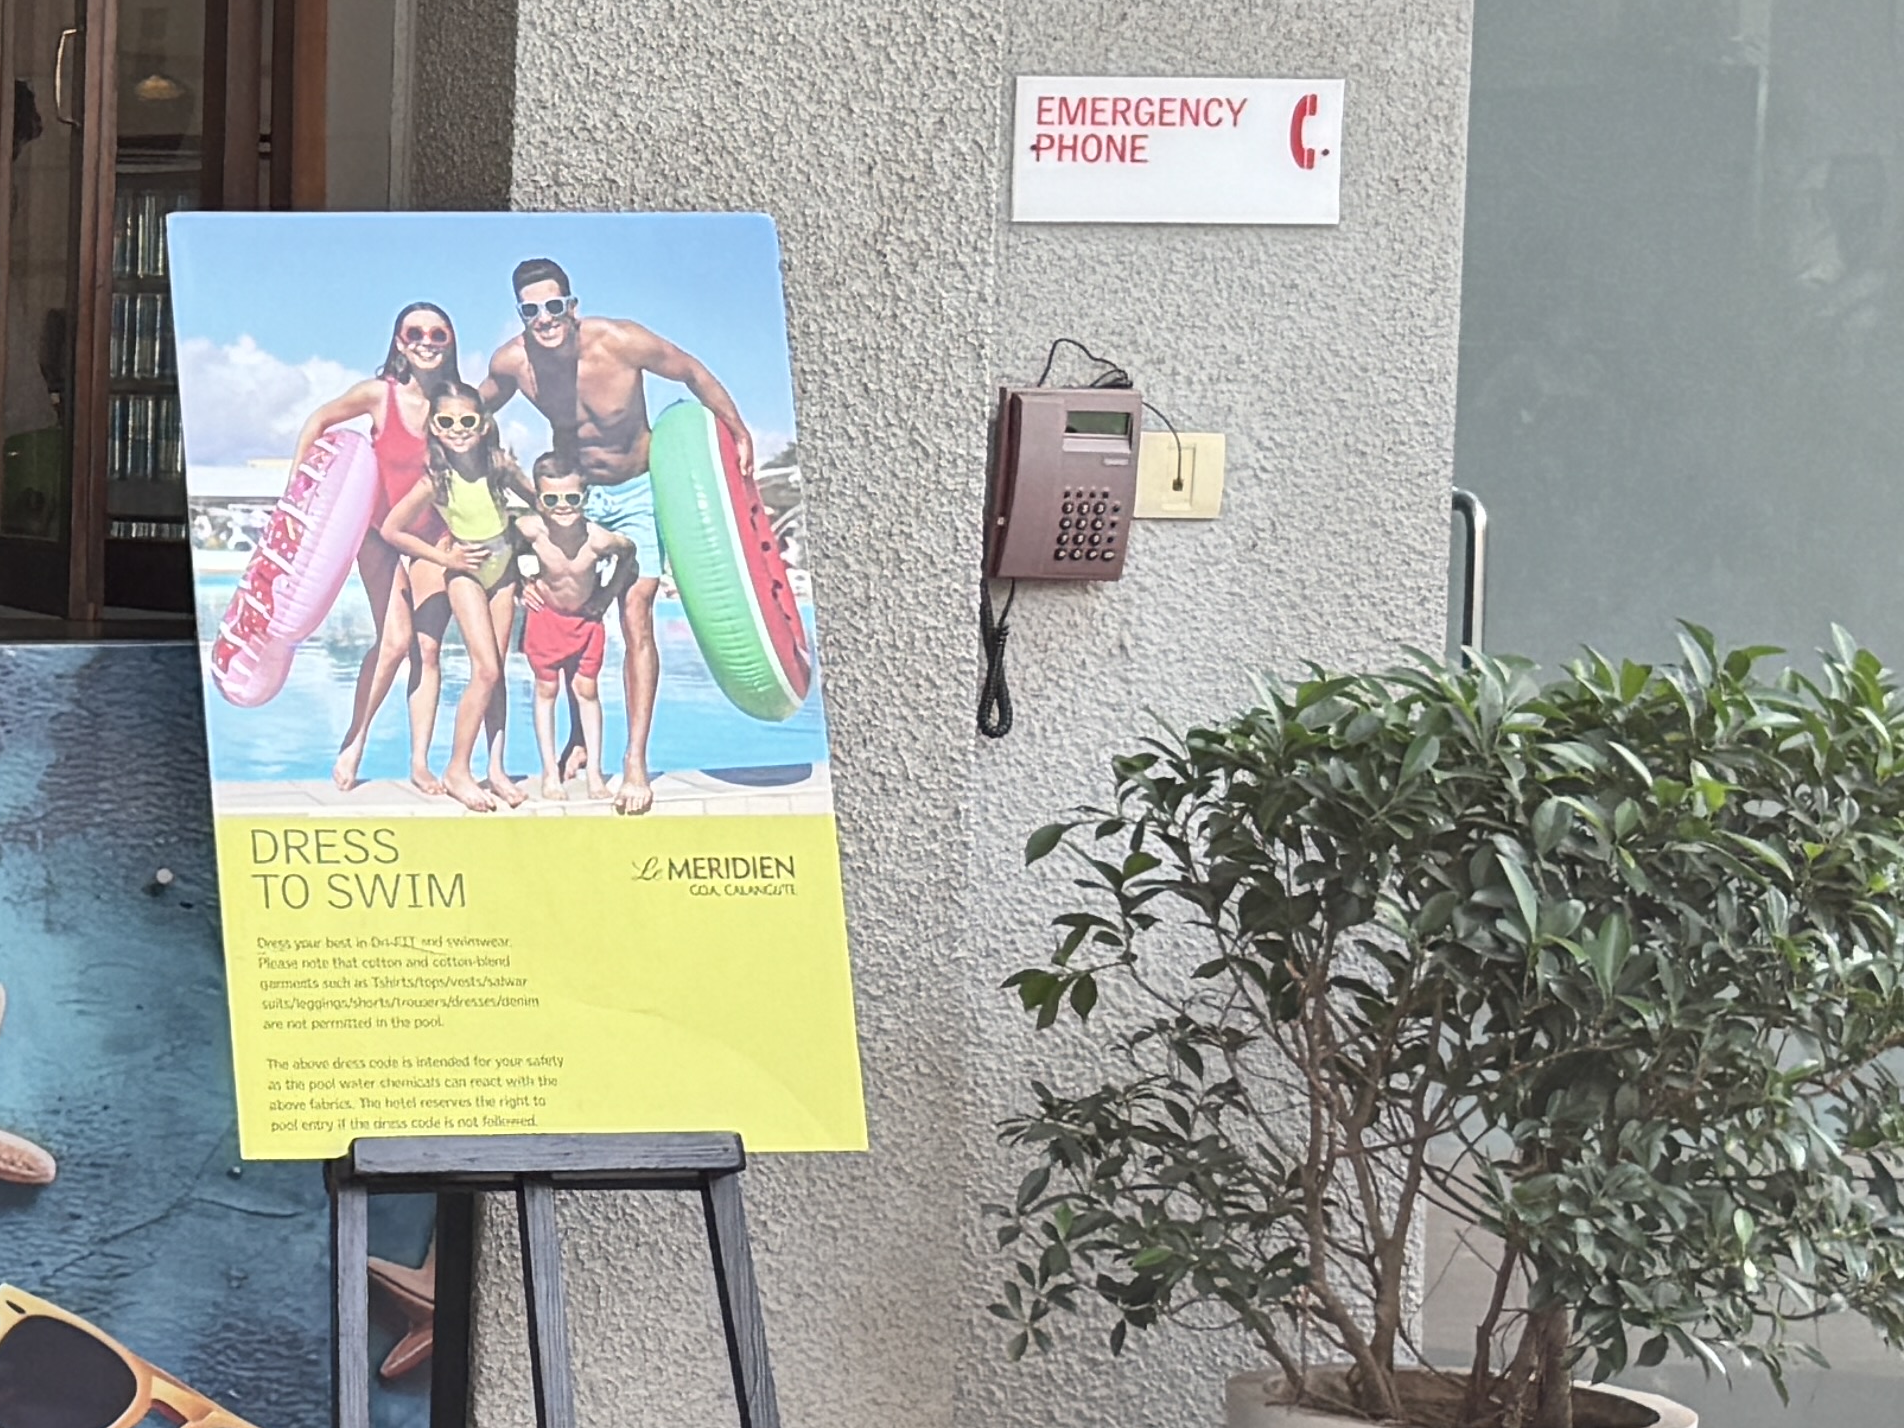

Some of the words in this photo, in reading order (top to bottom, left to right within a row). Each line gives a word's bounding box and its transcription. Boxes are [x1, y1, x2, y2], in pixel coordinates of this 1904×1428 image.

[1035, 95, 1248, 129] EMERGENCY
[1035, 133, 1149, 164] PHONE
[250, 828, 400, 865] DRESS
[668, 855, 796, 881] MERIDIEN
[251, 873, 310, 910] TO
[327, 872, 466, 910] SWIM
[266, 1058, 289, 1070] The
